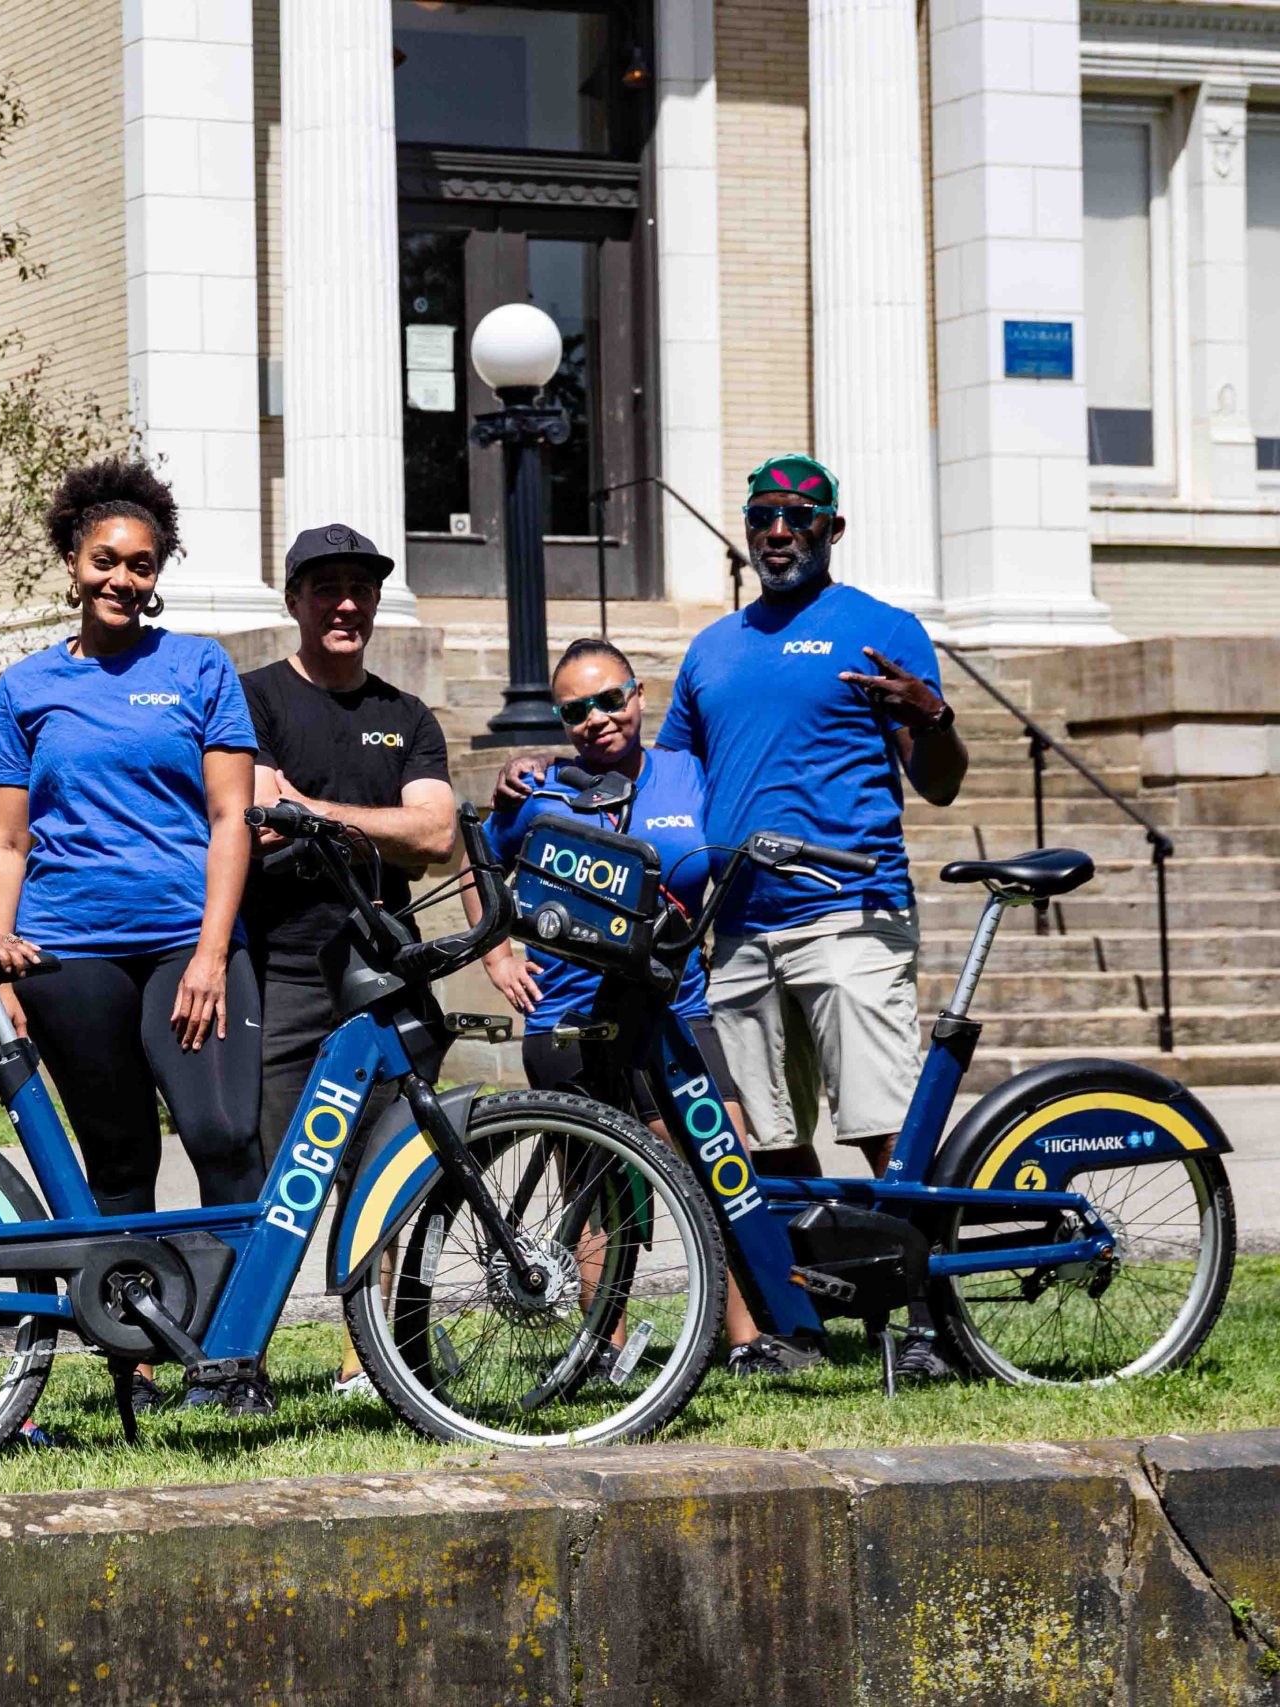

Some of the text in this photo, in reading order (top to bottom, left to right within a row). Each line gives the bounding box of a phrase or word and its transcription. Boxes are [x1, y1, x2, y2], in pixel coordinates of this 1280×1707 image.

[782, 640, 833, 655] POGOH
[129, 693, 180, 706] POGOH
[361, 731, 404, 747] POOH
[539, 843, 630, 896] POGOH
[266, 1078, 362, 1238] POGOH
[612, 1121, 643, 1146] CLASSIC
[642, 1144, 673, 1173] TUSCANY
[672, 1074, 763, 1222] POGOH
[1044, 1136, 1125, 1154] HIGHMARK
